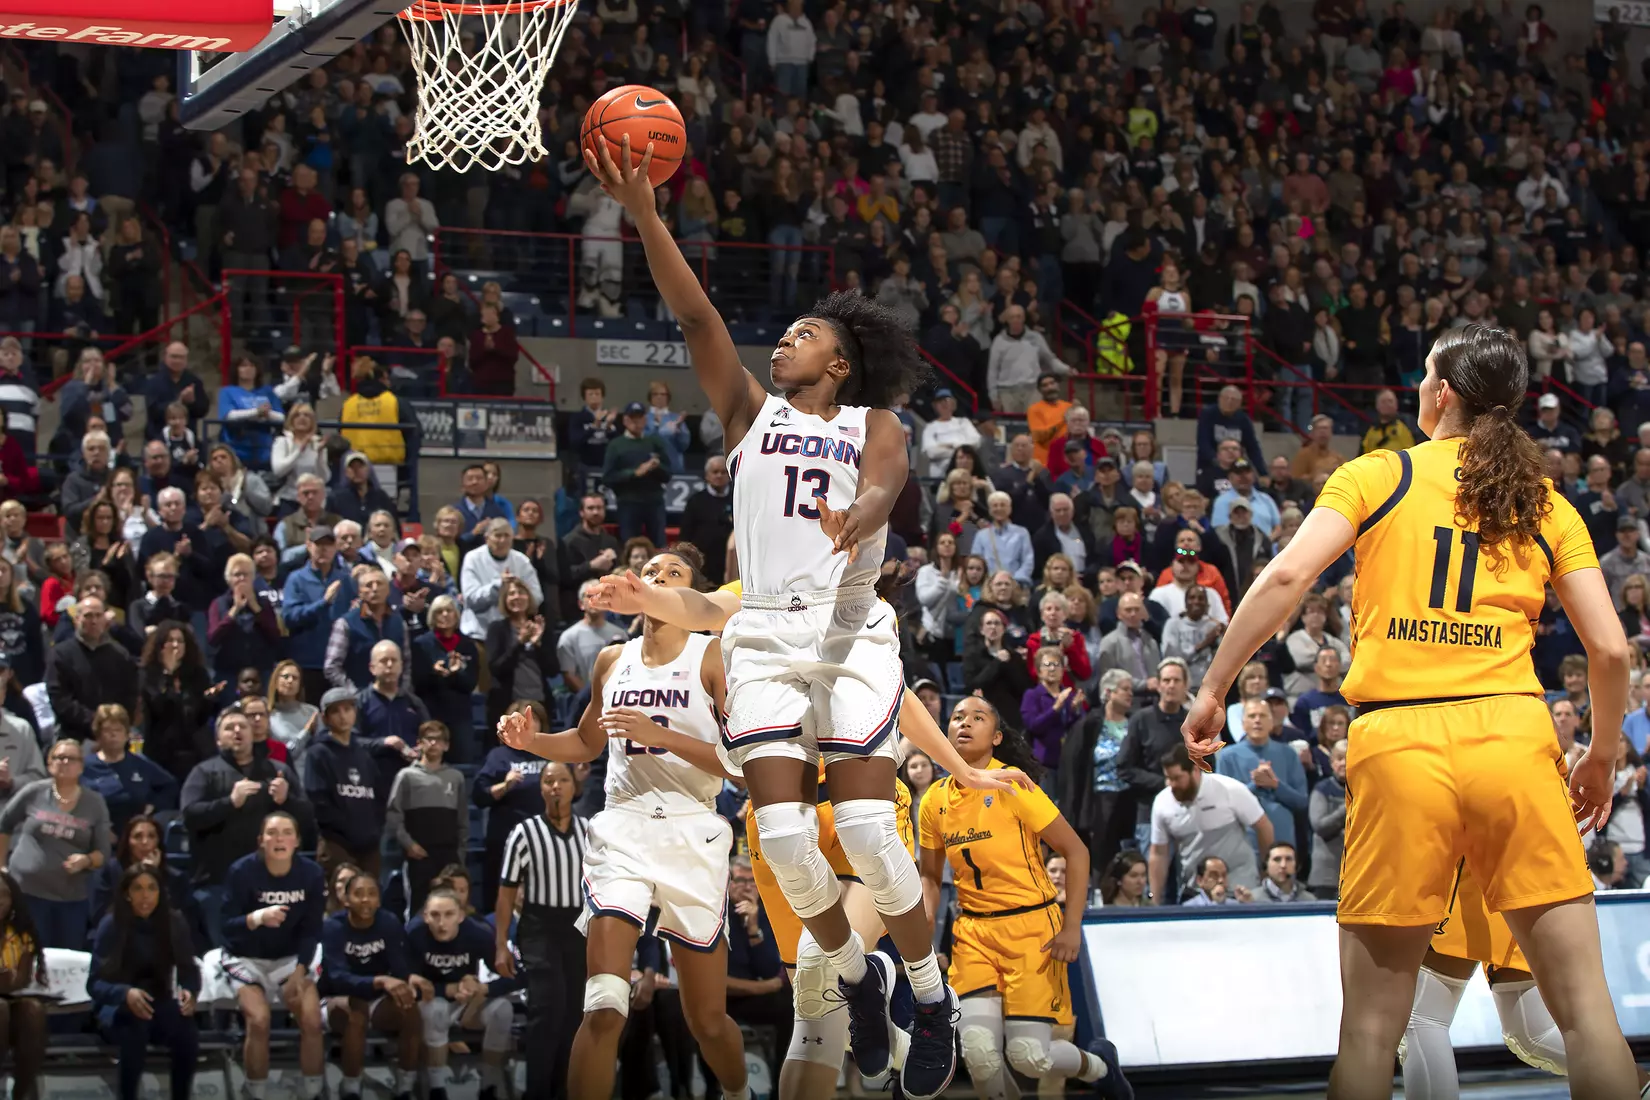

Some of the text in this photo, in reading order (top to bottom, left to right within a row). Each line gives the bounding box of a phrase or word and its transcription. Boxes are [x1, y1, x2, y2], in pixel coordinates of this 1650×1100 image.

[0, 22, 232, 50] te Farm
[648, 130, 679, 145] UCONN
[600, 342, 688, 364] SEC 221
[760, 432, 861, 471] UCONN
[783, 465, 831, 520] 13
[1428, 525, 1480, 613] 11
[787, 604, 808, 612] UCONN
[1386, 617, 1502, 649] ANASTASIESKA
[611, 689, 690, 708] UCONN
[336, 783, 375, 799] UCONN
[966, 827, 993, 841] Bears
[961, 847, 984, 890] 1
[425, 951, 470, 968] UCONN
